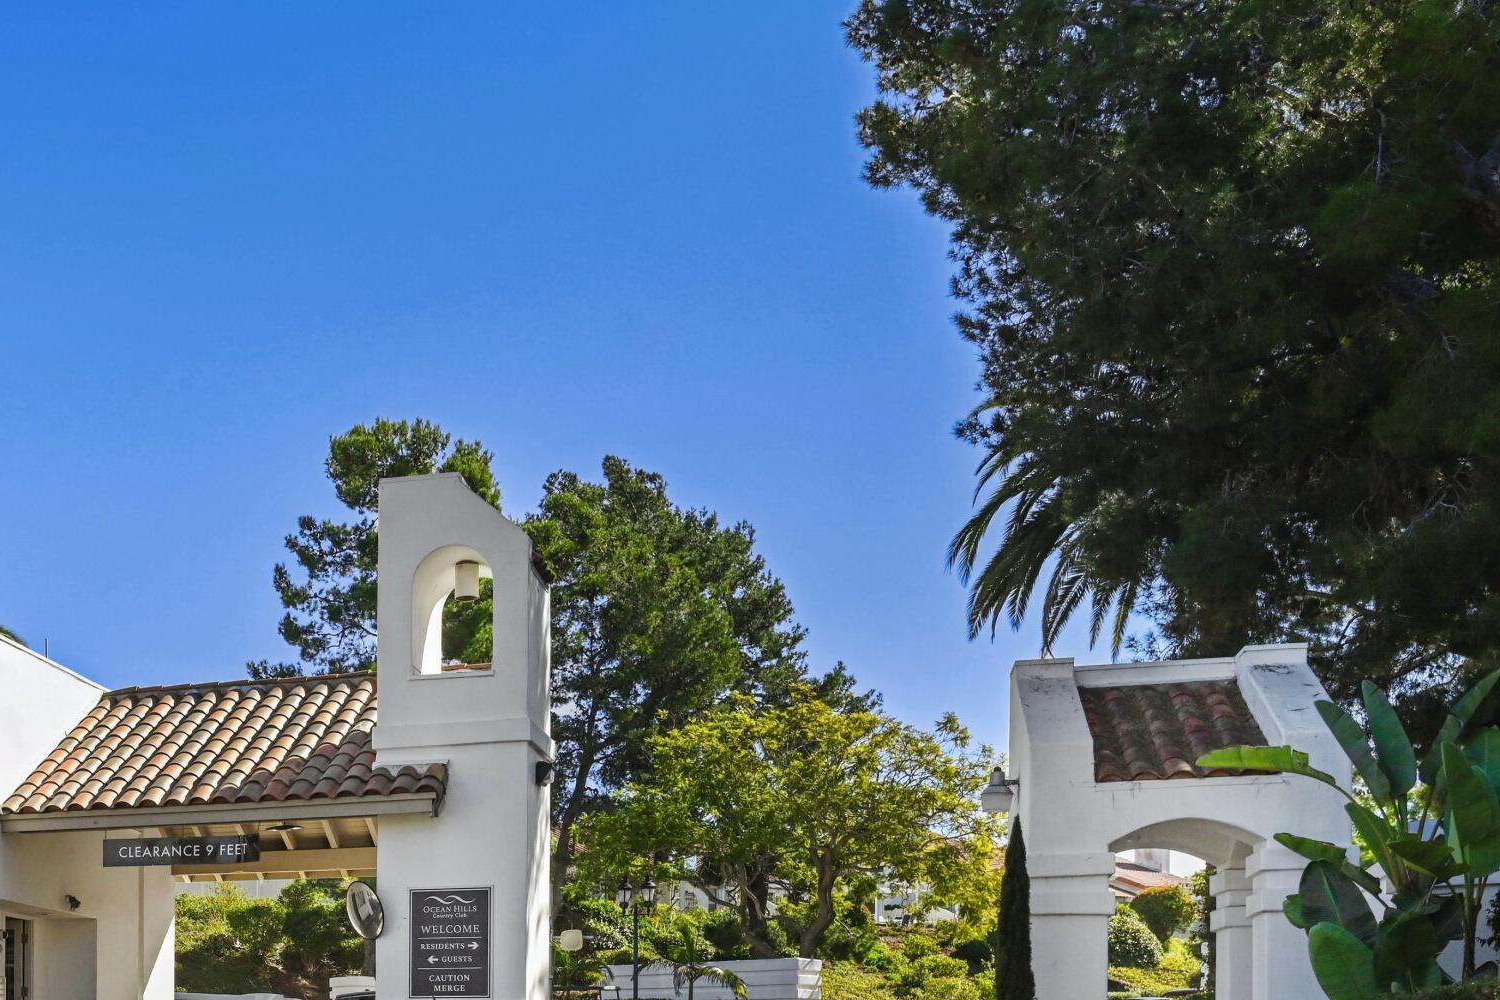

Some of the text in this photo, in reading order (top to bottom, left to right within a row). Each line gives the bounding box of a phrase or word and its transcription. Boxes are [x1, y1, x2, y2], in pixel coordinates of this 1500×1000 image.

[118, 843, 248, 858] CLEARANCE 9 FEET
[453, 905, 477, 913] HILLS
[420, 924, 480, 934] WELCOME
[441, 955, 473, 963] GUESTS
[428, 974, 470, 982] CAUTION
[433, 984, 466, 992] MERGE
